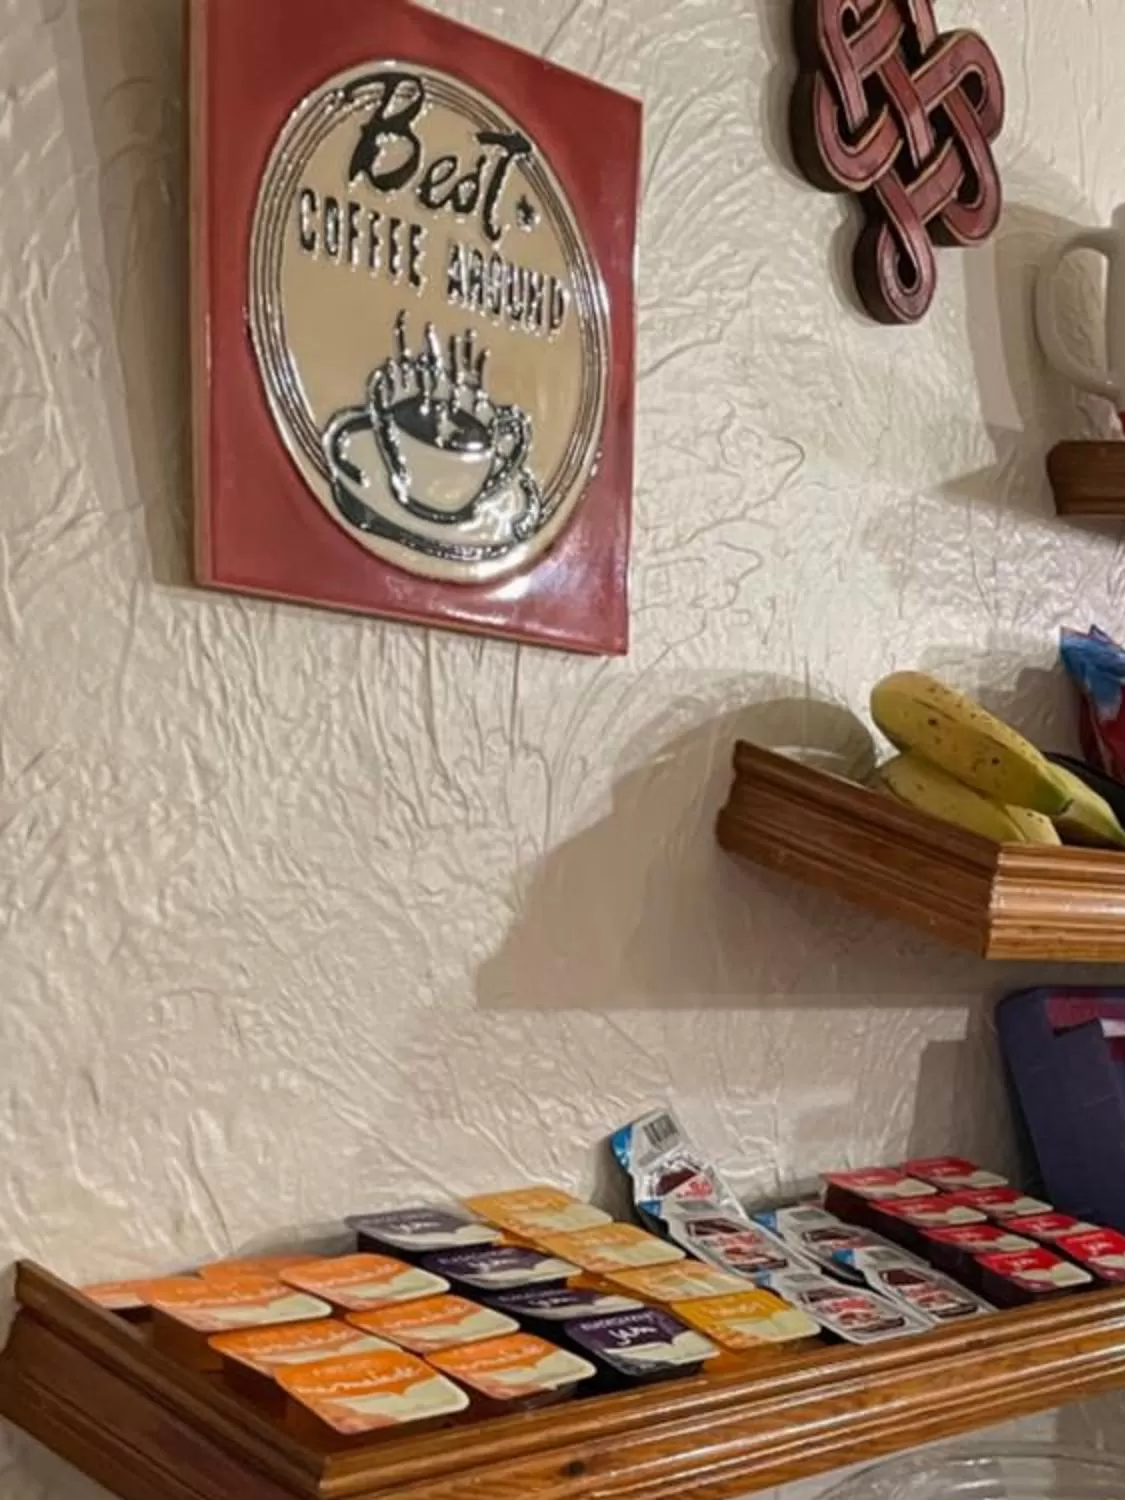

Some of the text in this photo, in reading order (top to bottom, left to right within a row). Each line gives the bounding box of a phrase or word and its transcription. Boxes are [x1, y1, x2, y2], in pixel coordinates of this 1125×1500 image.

[345, 72, 533, 240] Best
[301, 188, 567, 334] COFFEE AROUND
